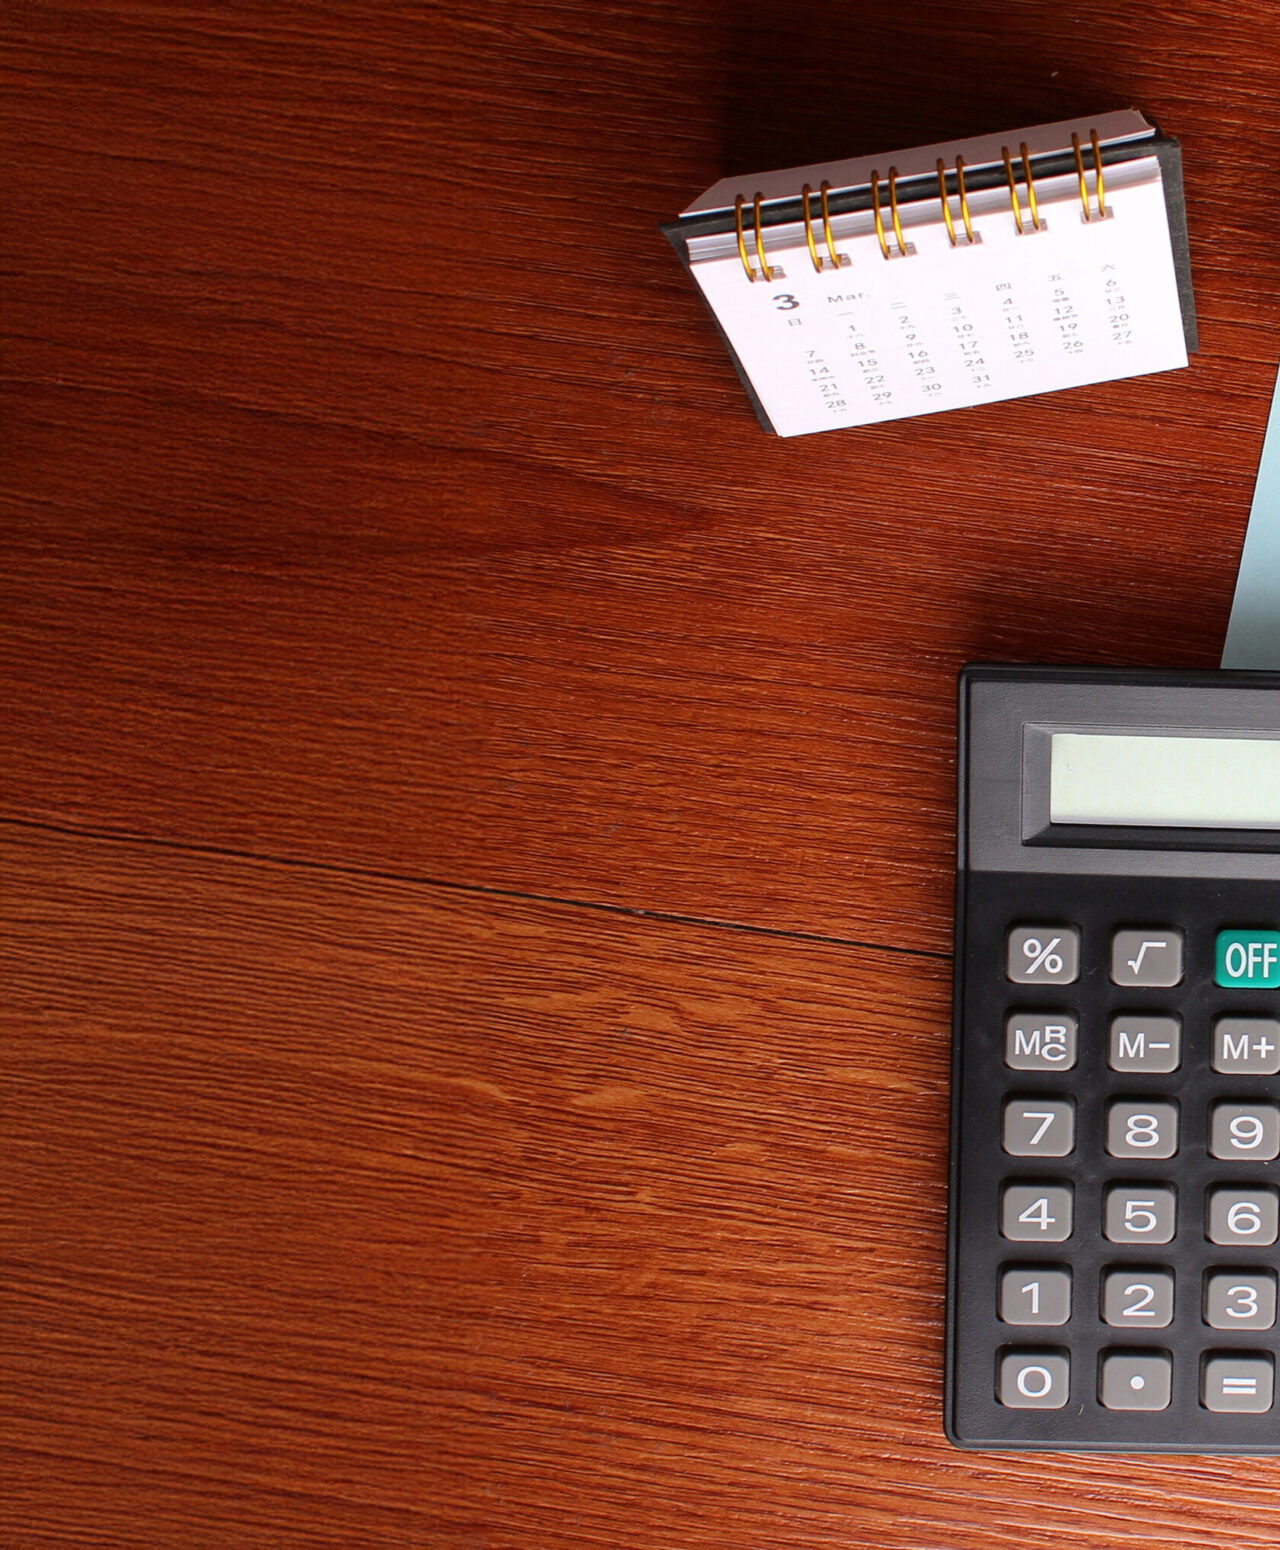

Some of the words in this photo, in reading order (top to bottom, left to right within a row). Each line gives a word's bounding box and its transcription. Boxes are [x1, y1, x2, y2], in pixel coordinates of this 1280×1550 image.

[772, 294, 800, 310] 3
[827, 293, 871, 303] Mar.
[899, 316, 910, 324] 2
[952, 307, 962, 315] 3
[1106, 279, 1117, 287] 6
[805, 350, 816, 358] 7
[855, 342, 865, 350] 8
[905, 333, 916, 341] 9
[952, 324, 973, 333] 10
[1006, 315, 1023, 324] 11
[1055, 306, 1073, 315] 12
[1105, 296, 1125, 305] 13
[809, 367, 829, 375] 14
[857, 359, 878, 367] 15
[908, 350, 928, 359] 16
[959, 341, 978, 350] 17
[1009, 332, 1029, 341] 18
[1060, 323, 1077, 332] 19
[1109, 314, 1129, 323] 20
[818, 383, 838, 392] 21
[865, 375, 886, 384] 22
[915, 367, 935, 376] 23
[964, 358, 985, 367] 24
[1014, 349, 1035, 359] 25
[1063, 340, 1083, 350] 26
[1112, 330, 1132, 340] 27
[826, 400, 847, 408] 28
[872, 392, 892, 401] 29
[921, 383, 942, 392] 30
[973, 375, 990, 383] 31
[1023, 937, 1063, 974] %
[1225, 943, 1278, 978] OFF
[1223, 1034, 1274, 1059] M+
[1022, 1112, 1055, 1145] 7
[1125, 1114, 1159, 1147] 8
[1229, 1116, 1264, 1149] 9
[1018, 1198, 1056, 1230] 4
[1124, 1201, 1158, 1233] 5
[1227, 1202, 1261, 1235] 6
[1020, 1283, 1040, 1313] 1
[1122, 1284, 1156, 1316] 2
[1225, 1285, 1258, 1318] 3
[1222, 1378, 1256, 1395] =
